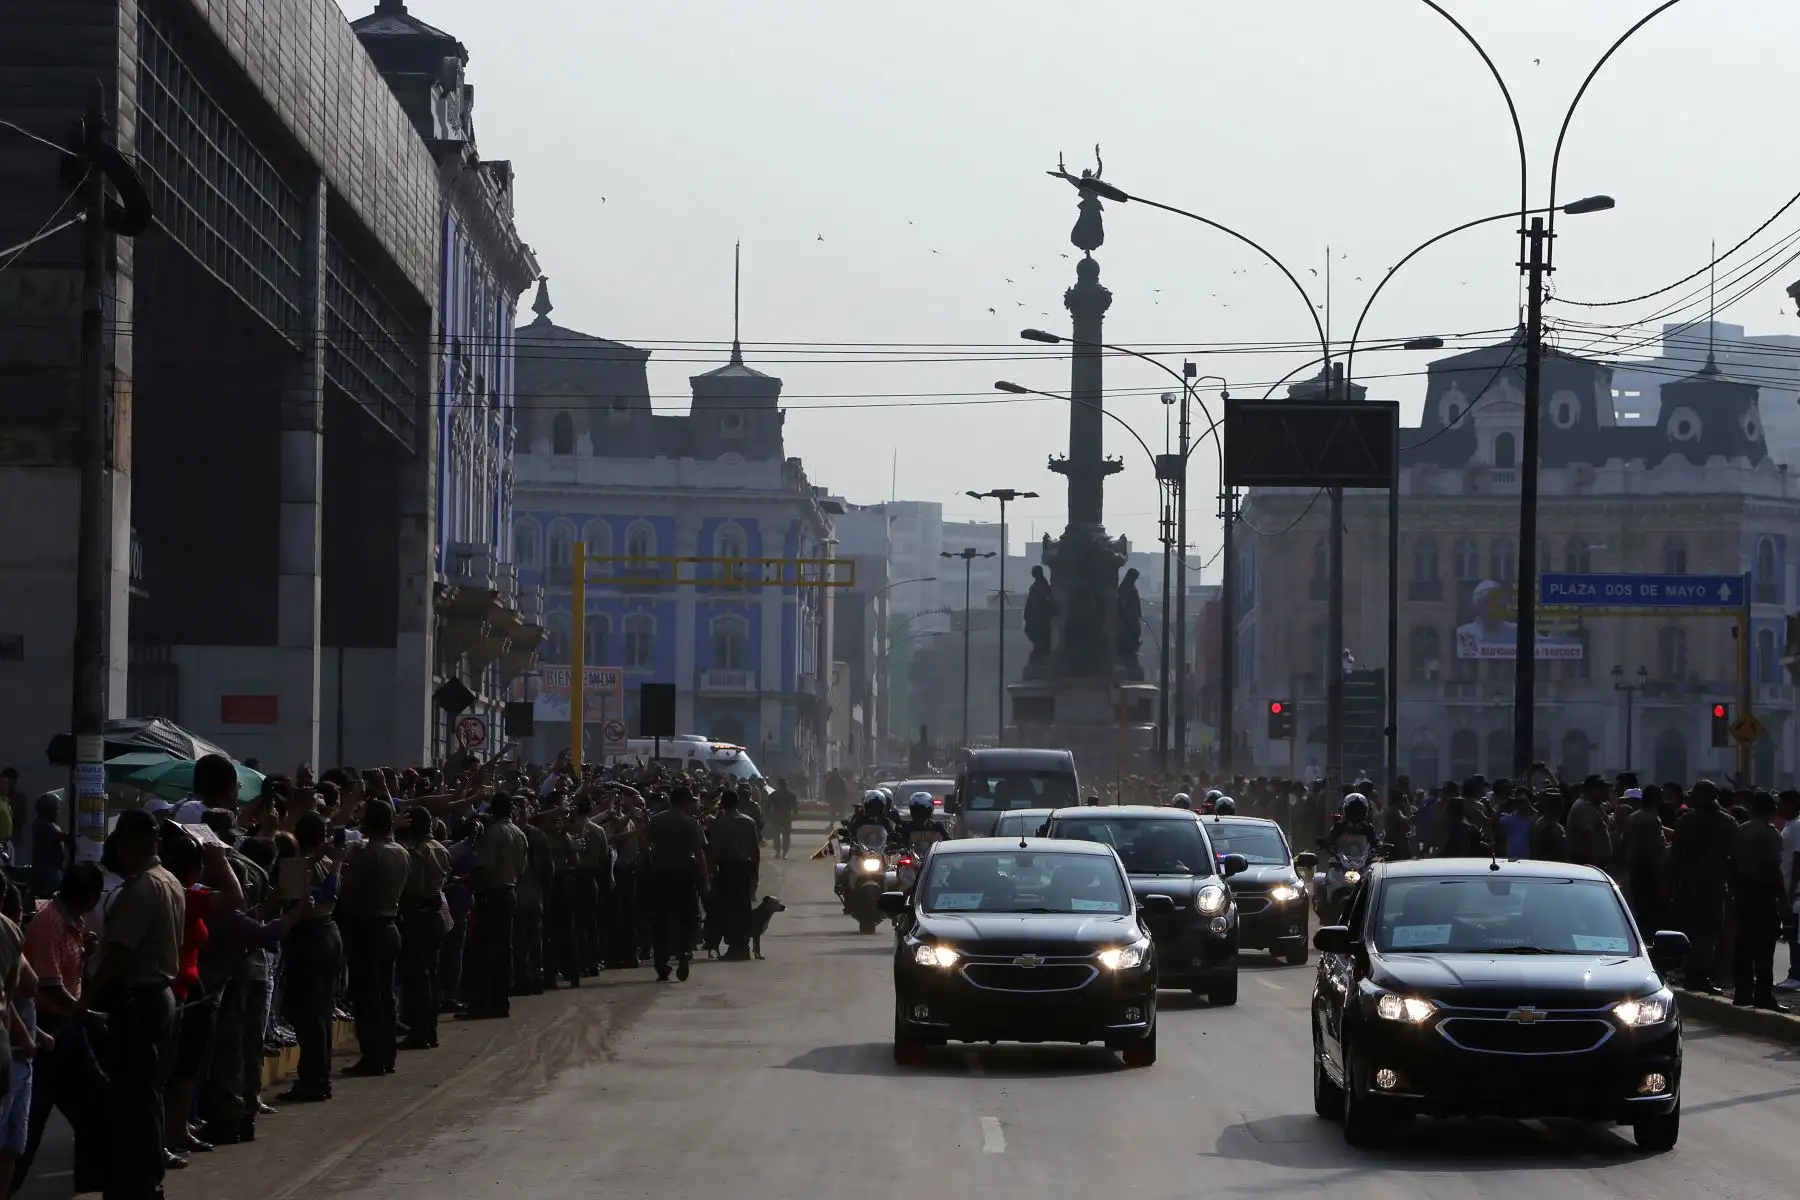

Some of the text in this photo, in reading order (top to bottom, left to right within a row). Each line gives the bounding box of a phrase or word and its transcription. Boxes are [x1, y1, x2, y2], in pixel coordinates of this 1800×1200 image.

[1550, 583, 1706, 597] PLAZA DOS DE MAYO
[1540, 647, 1581, 657] FRANCISCO
